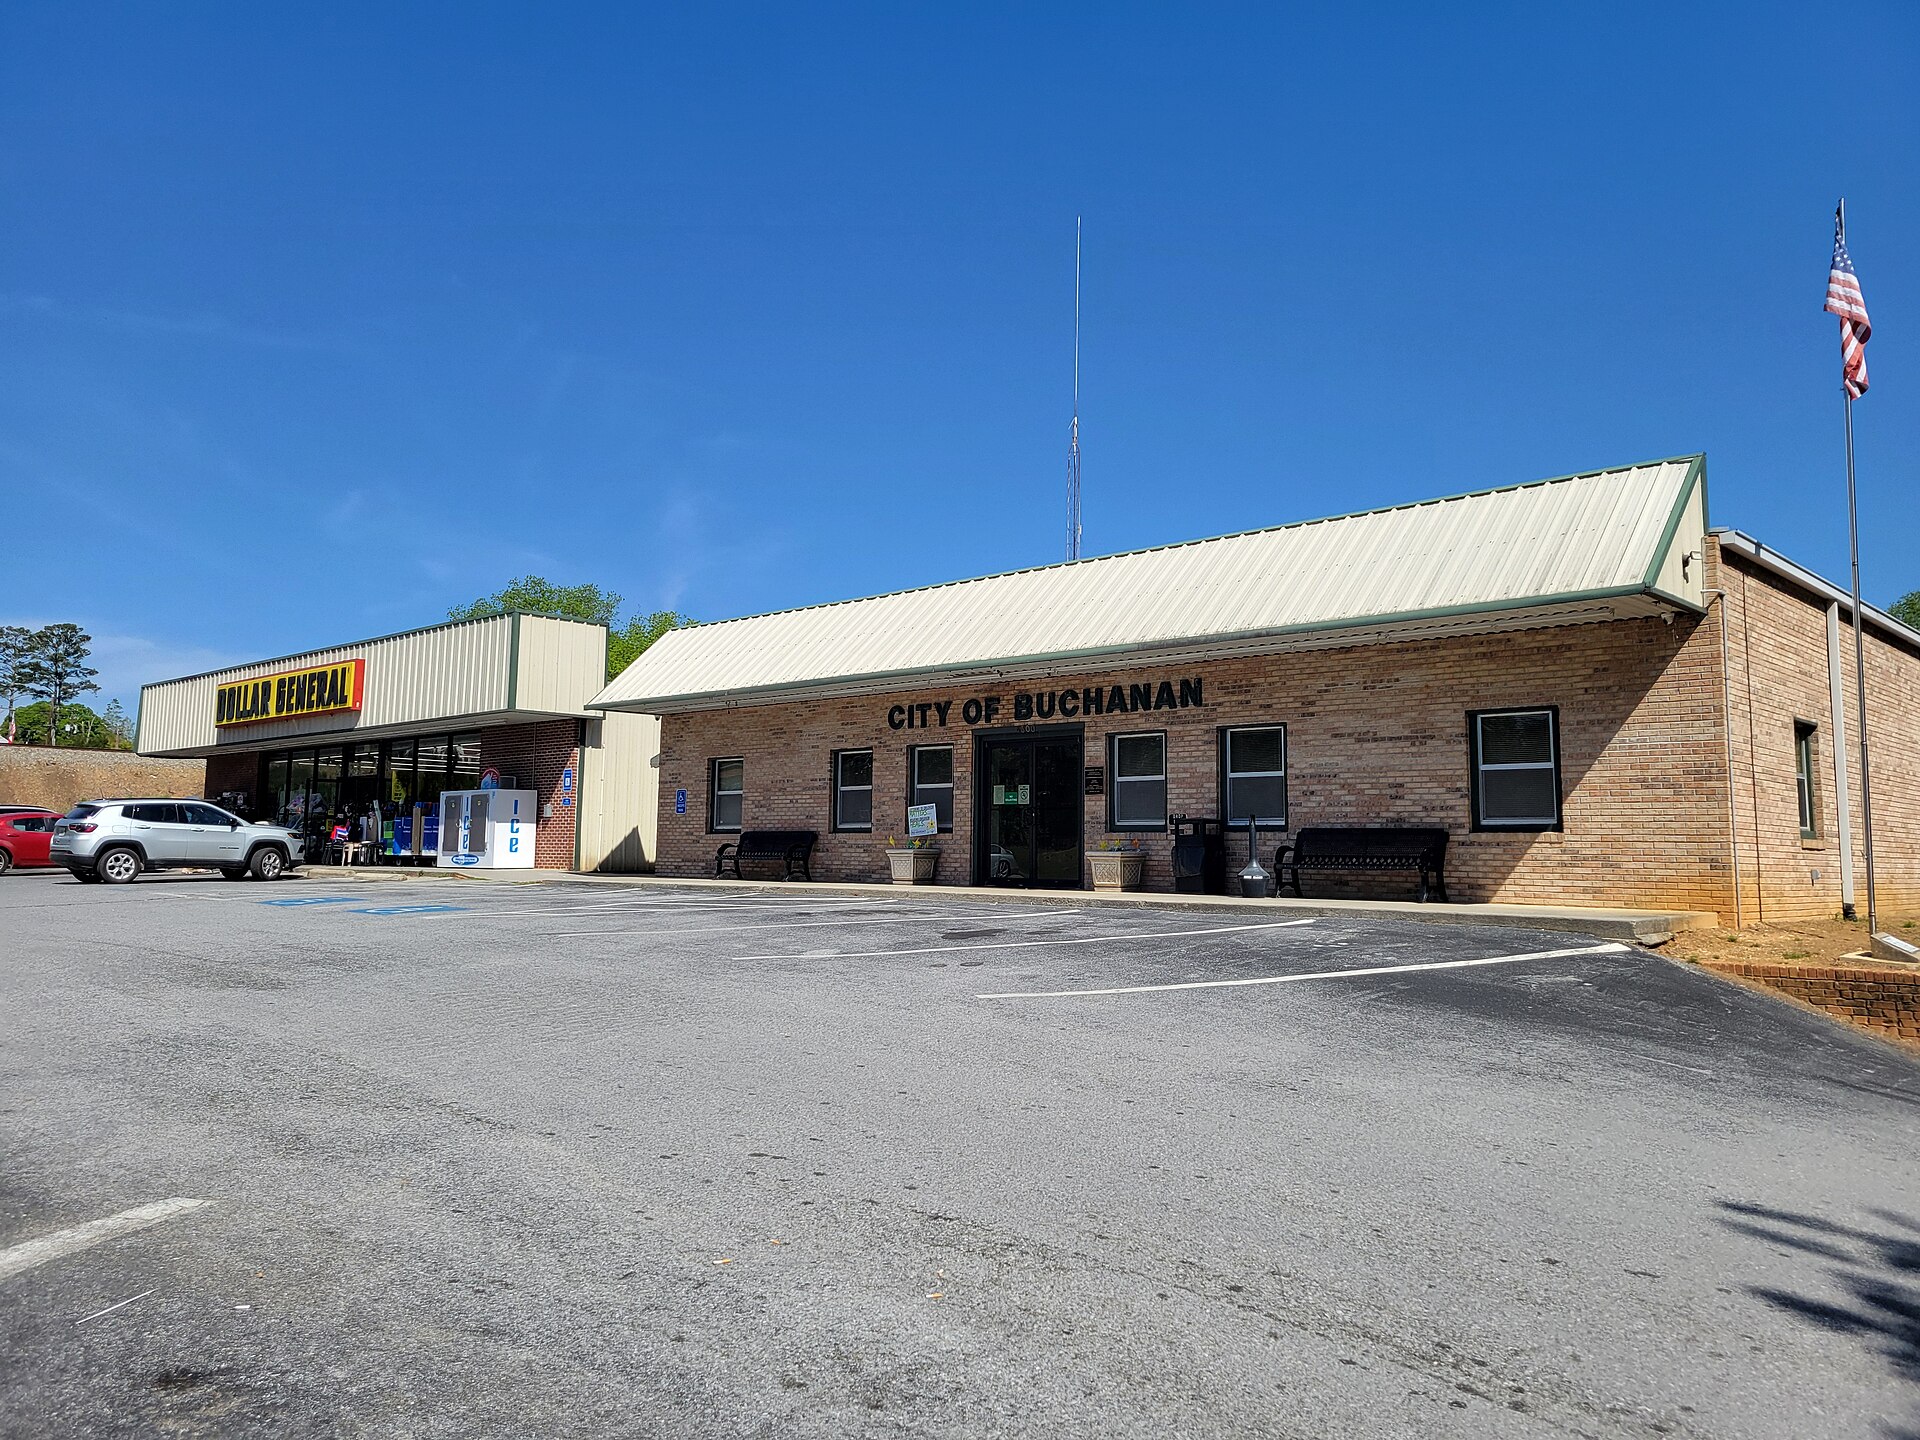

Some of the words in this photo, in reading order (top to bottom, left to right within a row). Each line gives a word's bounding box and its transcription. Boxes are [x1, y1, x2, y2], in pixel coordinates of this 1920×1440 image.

[217, 680, 271, 723] DOLLAR
[275, 667, 349, 715] GENERAL
[888, 700, 953, 730] CITY
[962, 697, 1000, 724] OF
[1014, 677, 1203, 721] BUCHANAN
